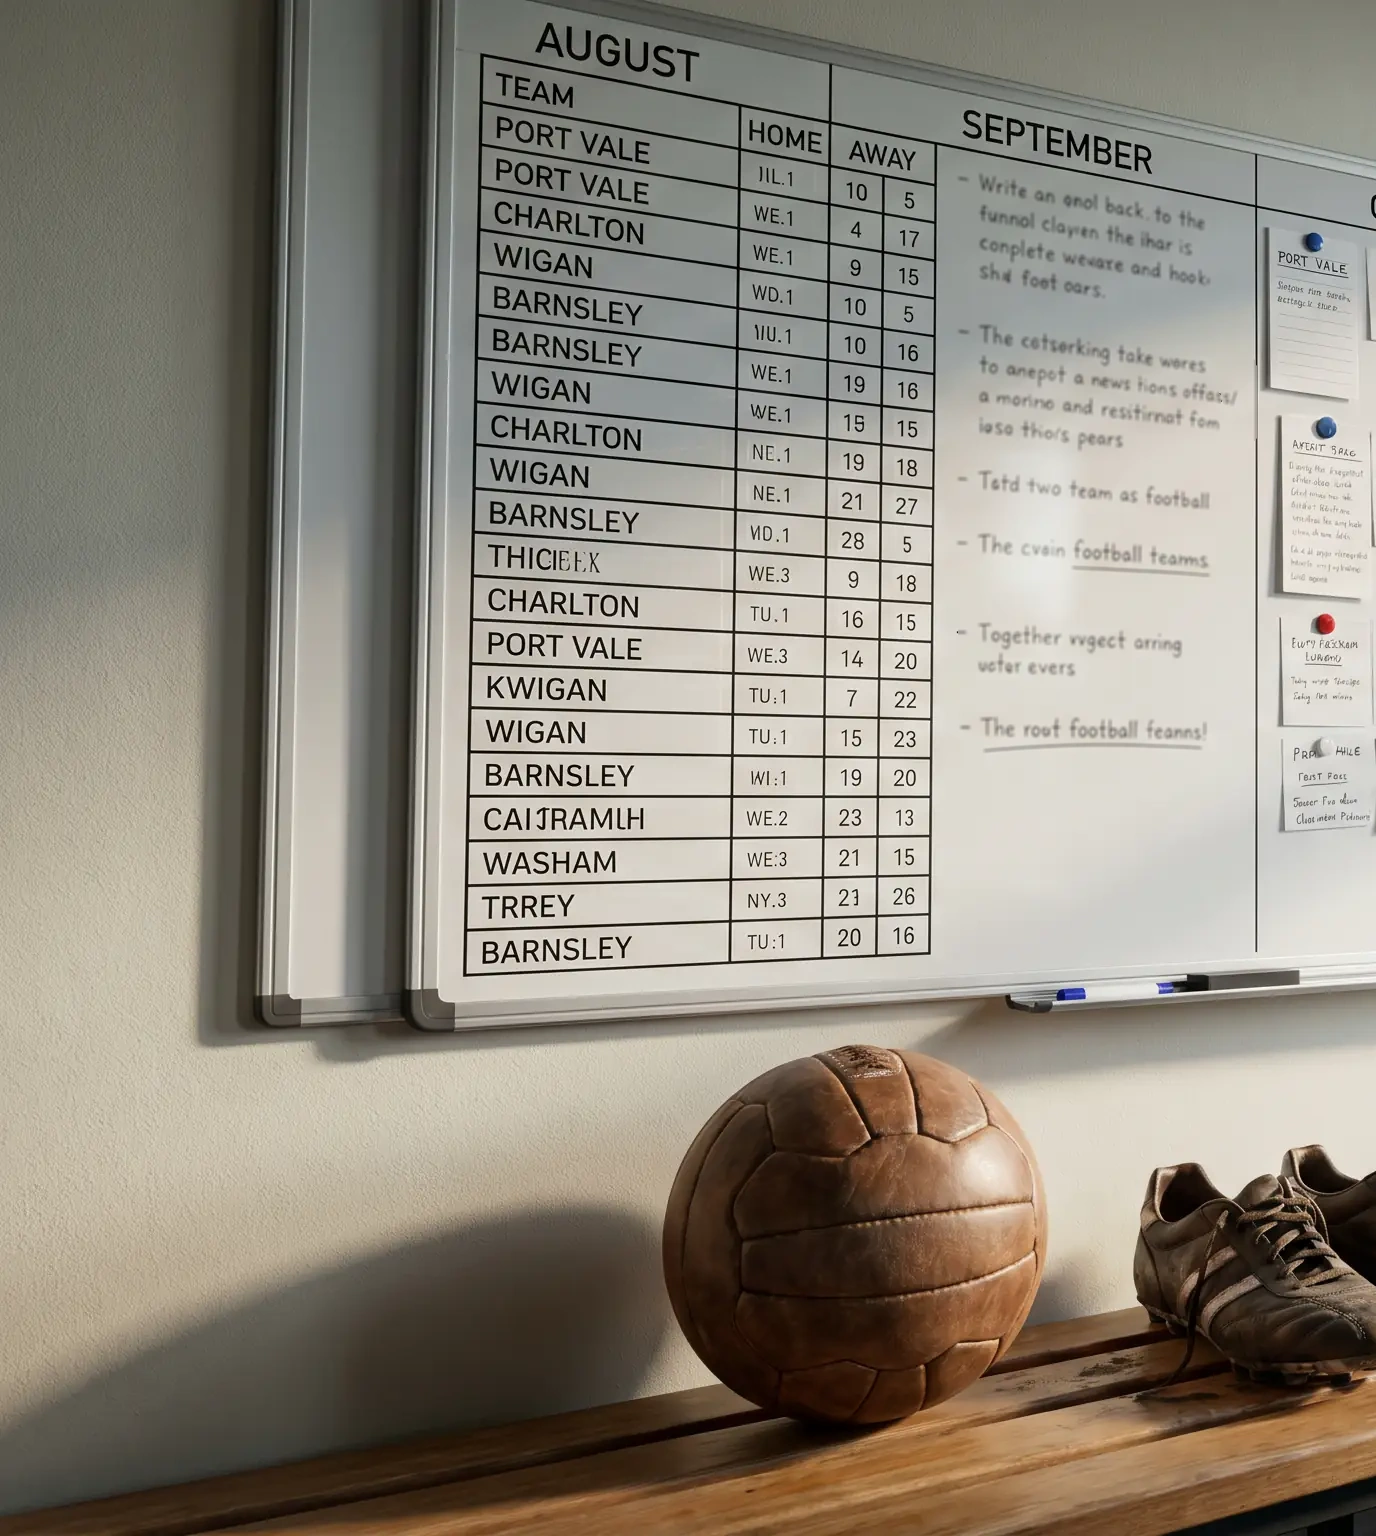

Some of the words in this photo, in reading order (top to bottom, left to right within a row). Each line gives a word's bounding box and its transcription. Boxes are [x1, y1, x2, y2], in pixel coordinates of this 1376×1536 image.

[535, 22, 699, 82] AUGUST
[496, 72, 573, 108] TEAM
[496, 116, 573, 151] PORT
[580, 131, 650, 164] VALE
[749, 120, 822, 154] HOME
[962, 109, 1153, 174] SEPTEMBER
[849, 140, 916, 171] AWAY
[495, 158, 572, 193] PORT
[580, 172, 650, 205] VALE
[846, 182, 867, 201] 10
[905, 192, 915, 209] 5
[979, 173, 1027, 199] Write
[1034, 189, 1056, 204] an
[1154, 206, 1172, 225] to
[1178, 210, 1206, 231] the
[494, 201, 643, 245] CHARLTON
[754, 205, 792, 226] WE.1
[851, 221, 861, 238] 4
[900, 230, 919, 247] 17
[1106, 225, 1134, 246] the
[1179, 239, 1193, 256] is
[494, 243, 592, 279] WIGAN
[753, 245, 792, 265] WE.1
[1278, 250, 1308, 267] PORT
[1315, 257, 1348, 275] VALE
[850, 259, 861, 276] 9
[899, 268, 919, 285] 15
[1131, 261, 1162, 279] and
[752, 284, 792, 305] WD.1
[494, 286, 643, 326] BARNSLEY
[845, 297, 866, 316] 10
[904, 306, 914, 323] 5
[493, 328, 642, 367] BARNSLEY
[845, 336, 866, 354] 10
[898, 344, 918, 362] 16
[978, 323, 1014, 348] The
[1117, 345, 1154, 367] take
[752, 364, 790, 384] WE.1
[979, 354, 999, 376] to
[1073, 373, 1085, 386] a
[1091, 375, 1131, 392] news
[491, 371, 590, 404] WIGAN
[844, 375, 865, 393] 19
[898, 382, 918, 400] 16
[979, 390, 990, 403] a
[1062, 397, 1094, 416] and
[751, 404, 790, 423] WE.1
[491, 415, 641, 451] CHARLTON
[898, 420, 917, 438] 15
[1078, 432, 1124, 452] pears
[753, 444, 789, 463] NE.1
[843, 453, 864, 471] 19
[490, 458, 589, 488] WIGAN
[897, 459, 917, 477] 18
[754, 485, 789, 503] NE.1
[842, 492, 861, 510] 21
[1026, 477, 1062, 497] two
[1070, 480, 1113, 500] team
[1119, 490, 1138, 503] as
[1146, 485, 1210, 510] football
[896, 497, 918, 515] 27
[490, 501, 639, 534] BARNSLEY
[842, 531, 864, 550] 28
[903, 536, 911, 553] 5
[978, 533, 1013, 556] The
[1074, 538, 1143, 563] football
[749, 565, 789, 583] WE.3
[848, 571, 859, 588] 9
[897, 574, 916, 592] 18
[488, 588, 638, 618] CHARLTON
[750, 606, 787, 623] TU.1
[842, 610, 863, 628] 16
[897, 614, 916, 631] 15
[978, 622, 1062, 650] Together
[488, 632, 563, 657] PORT
[572, 636, 642, 660] VALE
[748, 648, 787, 663] WE.3
[842, 650, 863, 667] 14
[895, 653, 917, 670] 20
[487, 676, 606, 701] KWIGAN
[847, 690, 857, 707] 7
[895, 691, 916, 708] 22
[486, 720, 586, 744] WIGAN
[980, 716, 1016, 738] The
[1069, 717, 1138, 740] football
[841, 729, 861, 747] 15
[894, 730, 916, 748] 23
[486, 764, 634, 787] BARNSLEY
[841, 769, 861, 786] 19
[894, 769, 916, 786] 20
[747, 811, 787, 826] WE.2
[839, 809, 861, 826] 23
[896, 809, 913, 826] 13
[483, 851, 616, 875] WASHAM
[839, 849, 858, 867] 21
[894, 848, 914, 866] 15
[748, 893, 786, 908] NY.3
[893, 887, 915, 905] 26
[482, 894, 575, 919] TRREY
[838, 928, 861, 947] 20
[893, 926, 914, 944] 16
[482, 936, 632, 964] BARNSLEY
